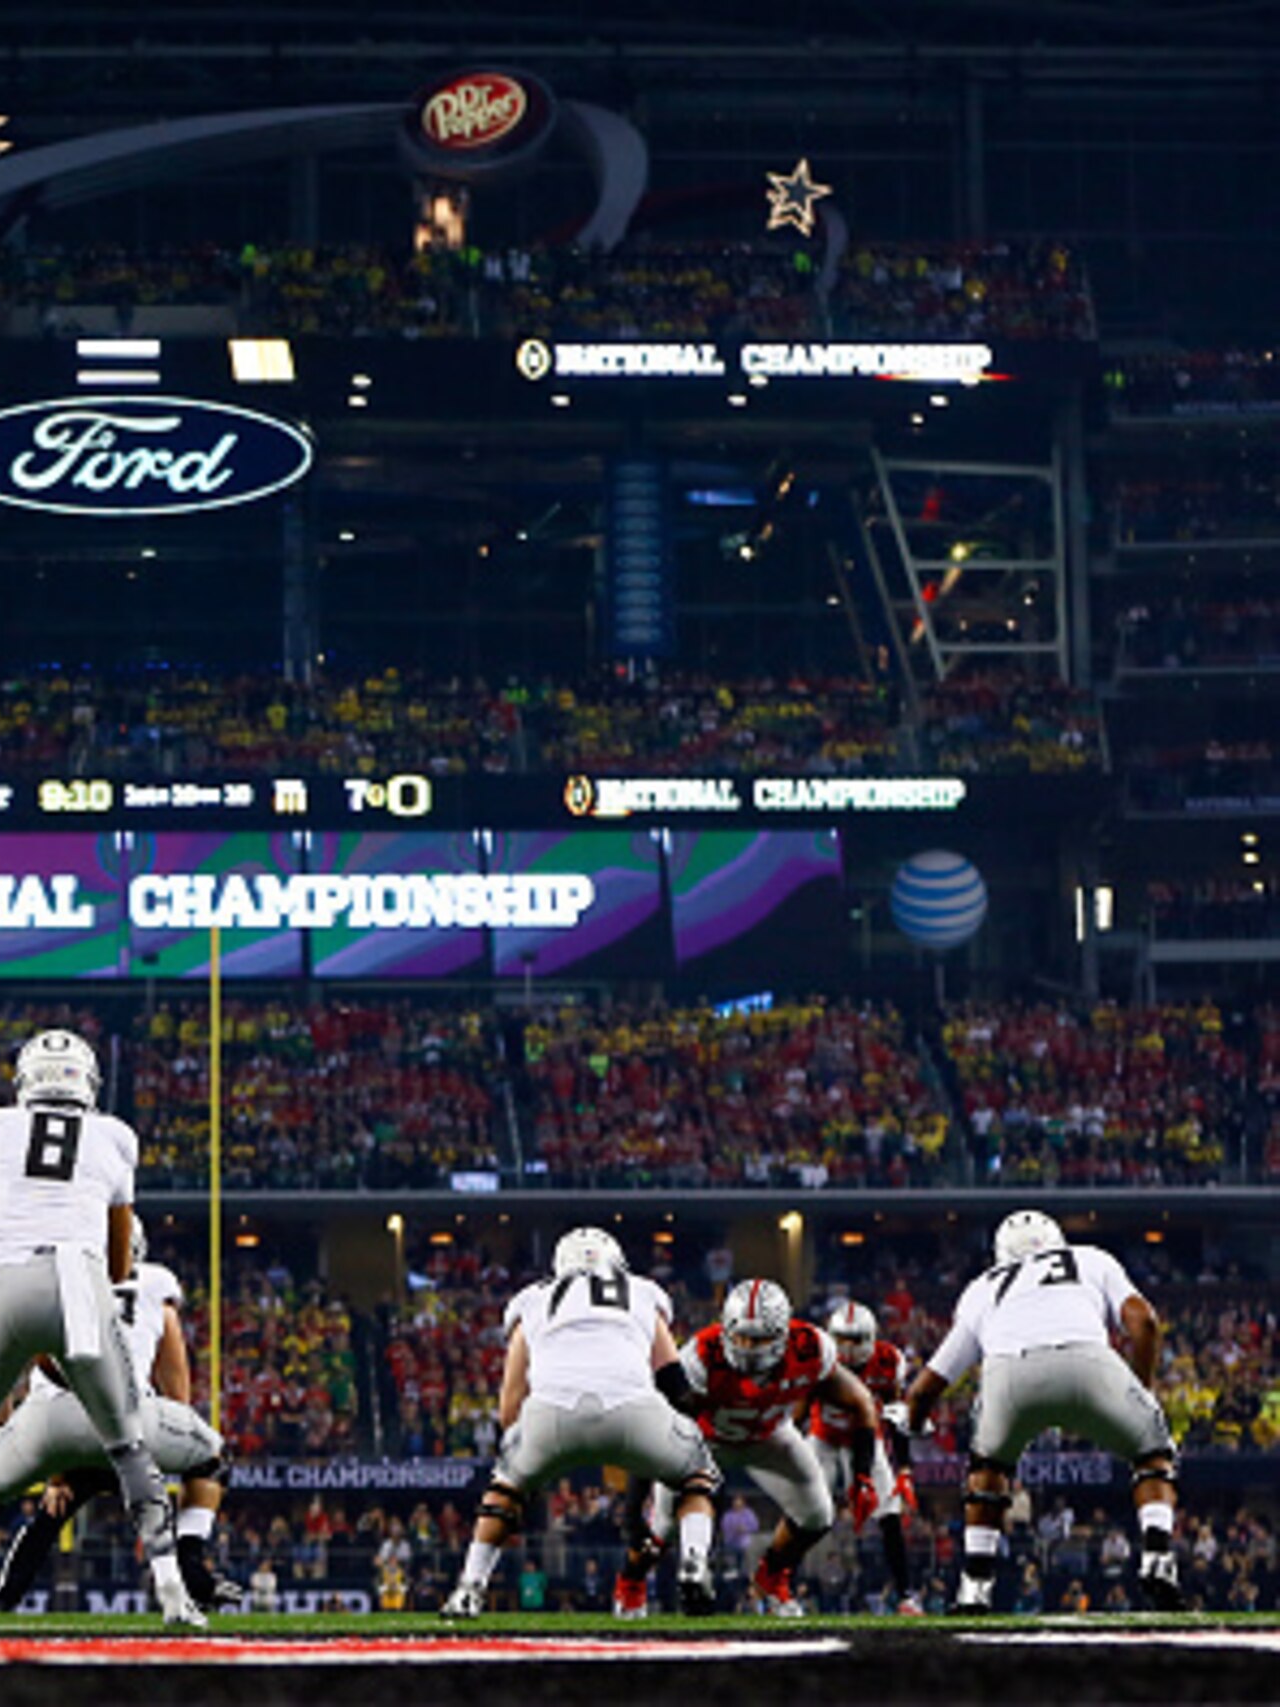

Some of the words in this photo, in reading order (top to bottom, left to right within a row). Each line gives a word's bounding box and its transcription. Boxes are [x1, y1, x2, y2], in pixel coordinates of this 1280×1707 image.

[423, 92, 514, 140] Pepper
[456, 85, 493, 109] Dr
[556, 345, 724, 374] NATIONAL
[742, 345, 991, 375] CHAMPIONSHIP
[10, 409, 240, 492] Ford
[596, 779, 740, 811] NATIONAL
[754, 779, 966, 809] CHAMPIONSHIP
[130, 874, 594, 928] CHAMPIONSHIP
[24, 1112, 82, 1182] 8
[986, 1249, 1081, 1307] 73
[287, 1462, 475, 1489] CHAMPIONSHIP
